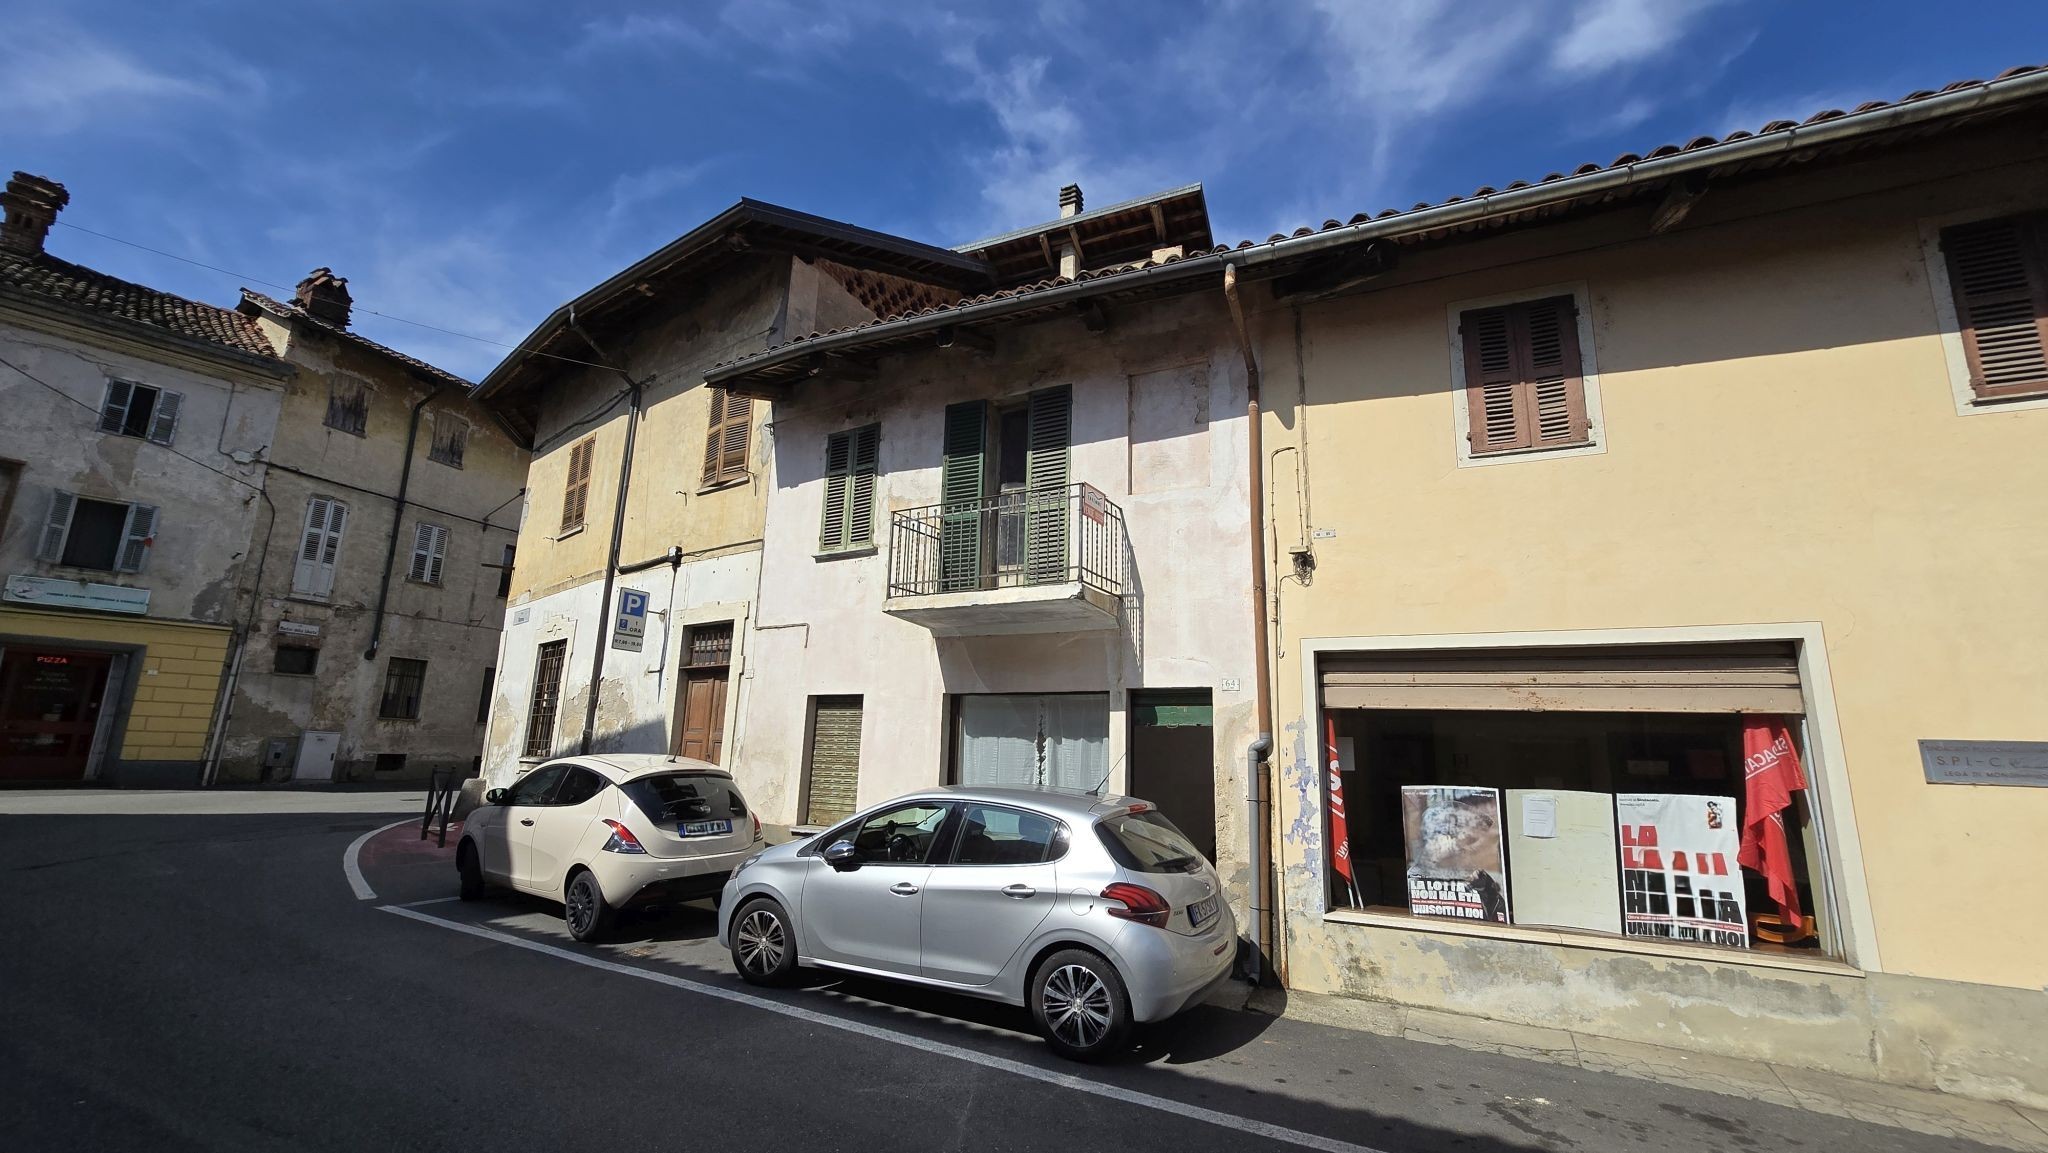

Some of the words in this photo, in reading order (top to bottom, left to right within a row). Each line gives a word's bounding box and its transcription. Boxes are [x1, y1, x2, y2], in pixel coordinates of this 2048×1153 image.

[626, 594, 642, 613] P
[36, 656, 68, 664] PIZZA
[1225, 679, 1236, 688] 64
[1622, 825, 1658, 847] LA
[1411, 880, 1426, 890] LA
[1427, 880, 1466, 892] LOTTA
[1411, 889, 1437, 900] NON
[1439, 890, 1457, 901] HA
[1459, 889, 1482, 903] ETÀ
[1412, 903, 1456, 916] UNISCITI
[1457, 906, 1465, 917] A
[1465, 907, 1484, 919] NOI
